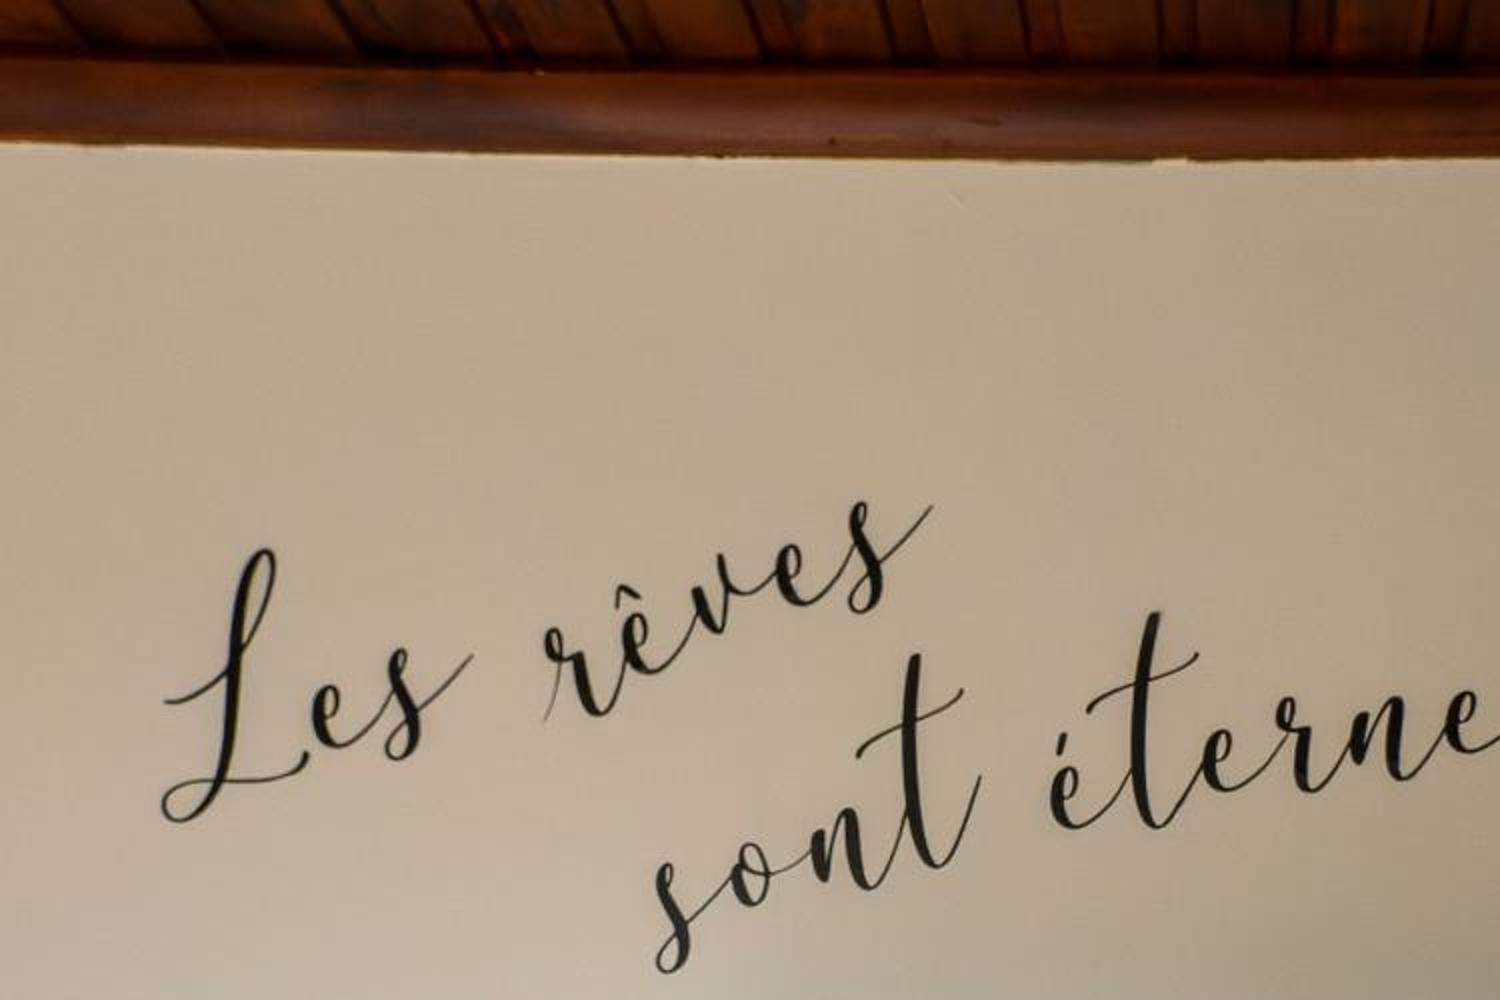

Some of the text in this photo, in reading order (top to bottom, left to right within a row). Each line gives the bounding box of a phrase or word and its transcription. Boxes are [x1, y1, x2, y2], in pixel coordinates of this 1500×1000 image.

[162, 500, 934, 824] Les rêves
[655, 652, 982, 974] sont
